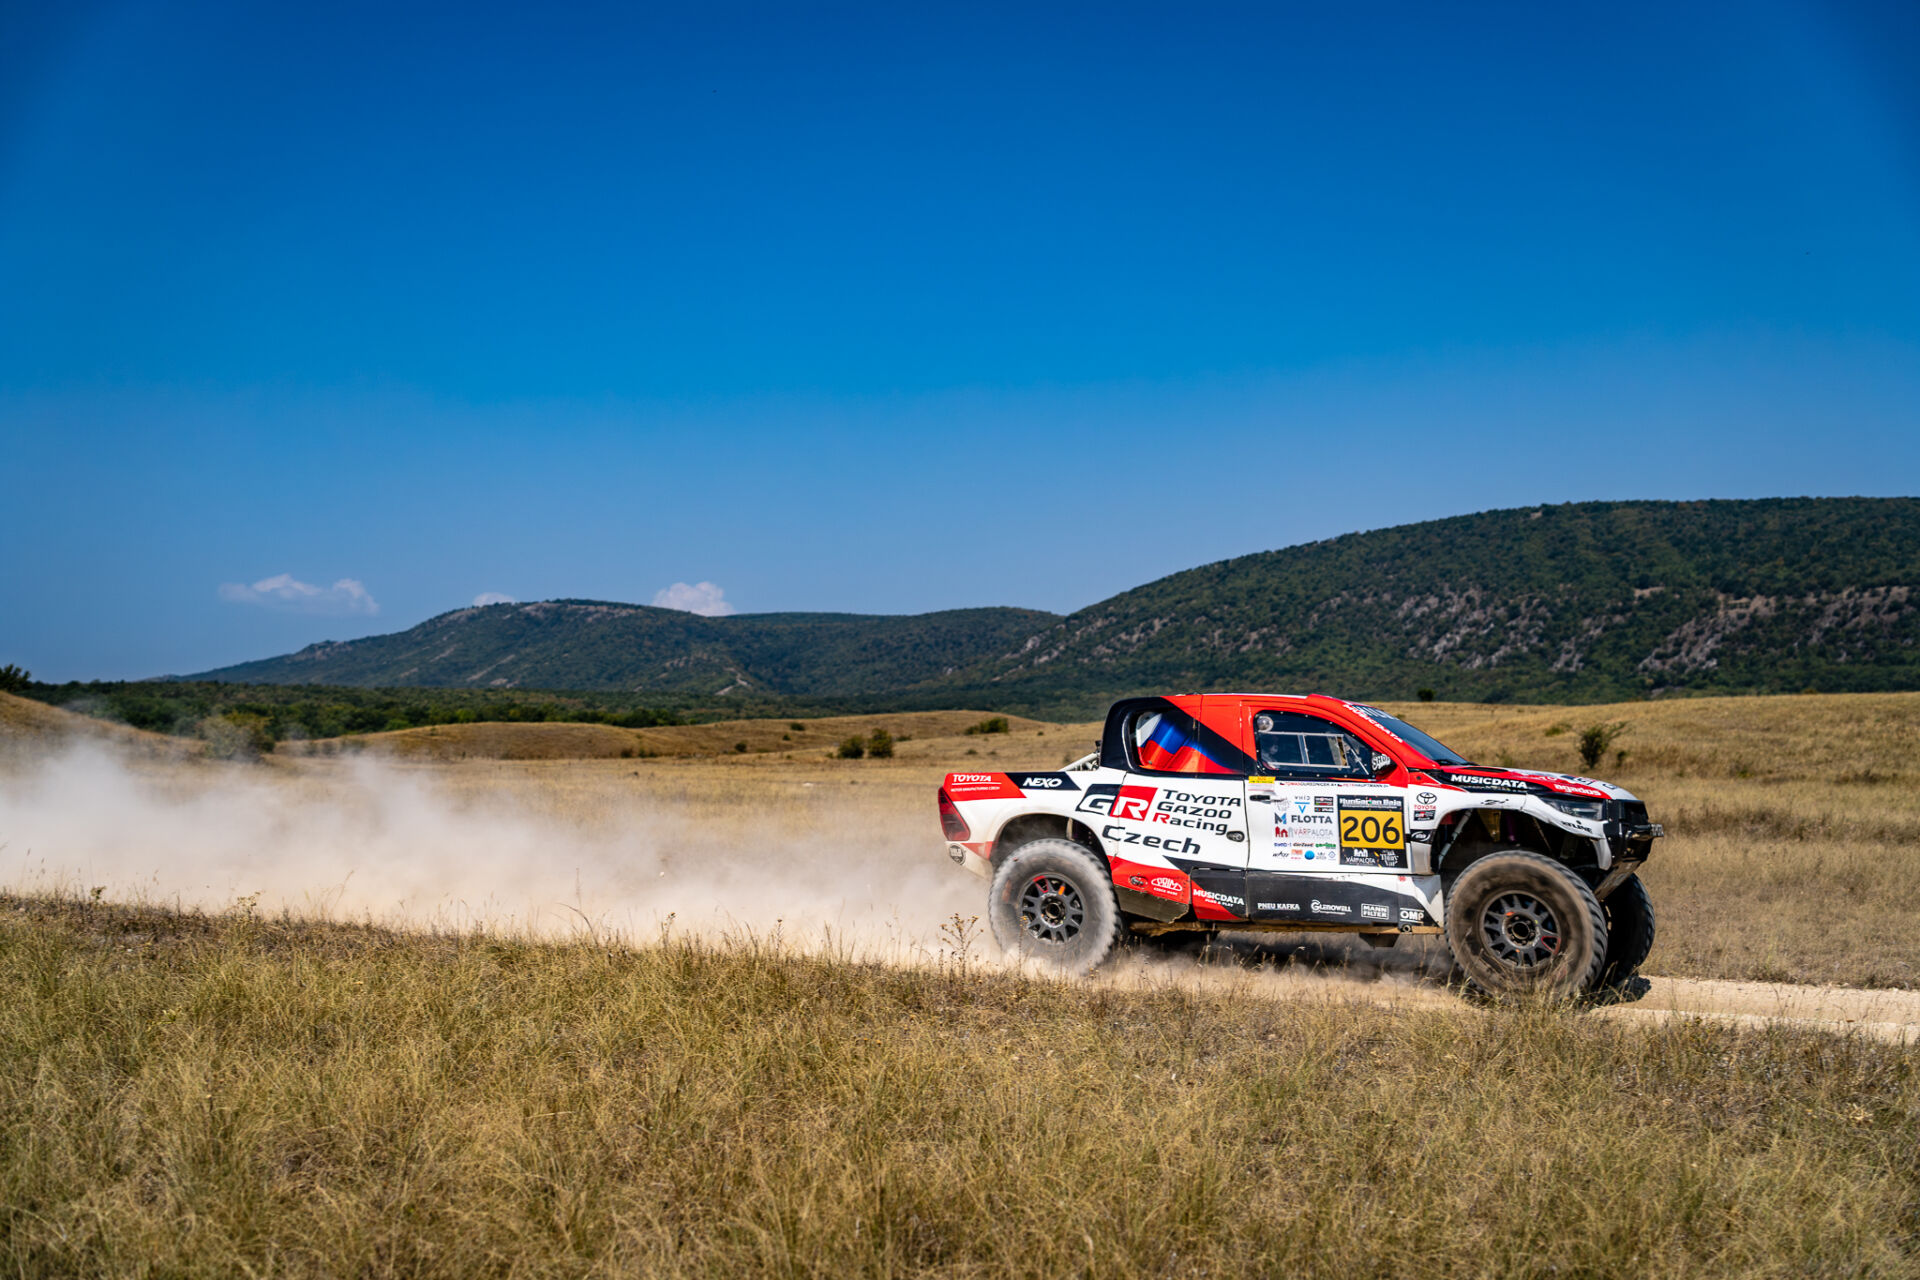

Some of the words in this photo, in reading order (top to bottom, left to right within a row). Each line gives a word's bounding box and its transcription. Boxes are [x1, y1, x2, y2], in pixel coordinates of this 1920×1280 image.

[953, 774, 992, 782] TOYOTA
[1022, 777, 1063, 788] NEXO
[1450, 774, 1528, 789] MUSICDATA
[1076, 790, 1151, 821] GR
[1162, 788, 1241, 807] TOYOTA
[1157, 801, 1232, 819] GAZOO
[1152, 812, 1228, 836] Racing
[1290, 815, 1333, 824] FLOTTA
[1342, 816, 1400, 845] 206
[1102, 824, 1201, 855] Czech
[1193, 888, 1245, 905] MUSICDATA
[1257, 902, 1277, 910] PNEU
[1277, 903, 1301, 911] KAFKA
[1363, 904, 1387, 912] MANN
[1400, 910, 1424, 921] OMP
